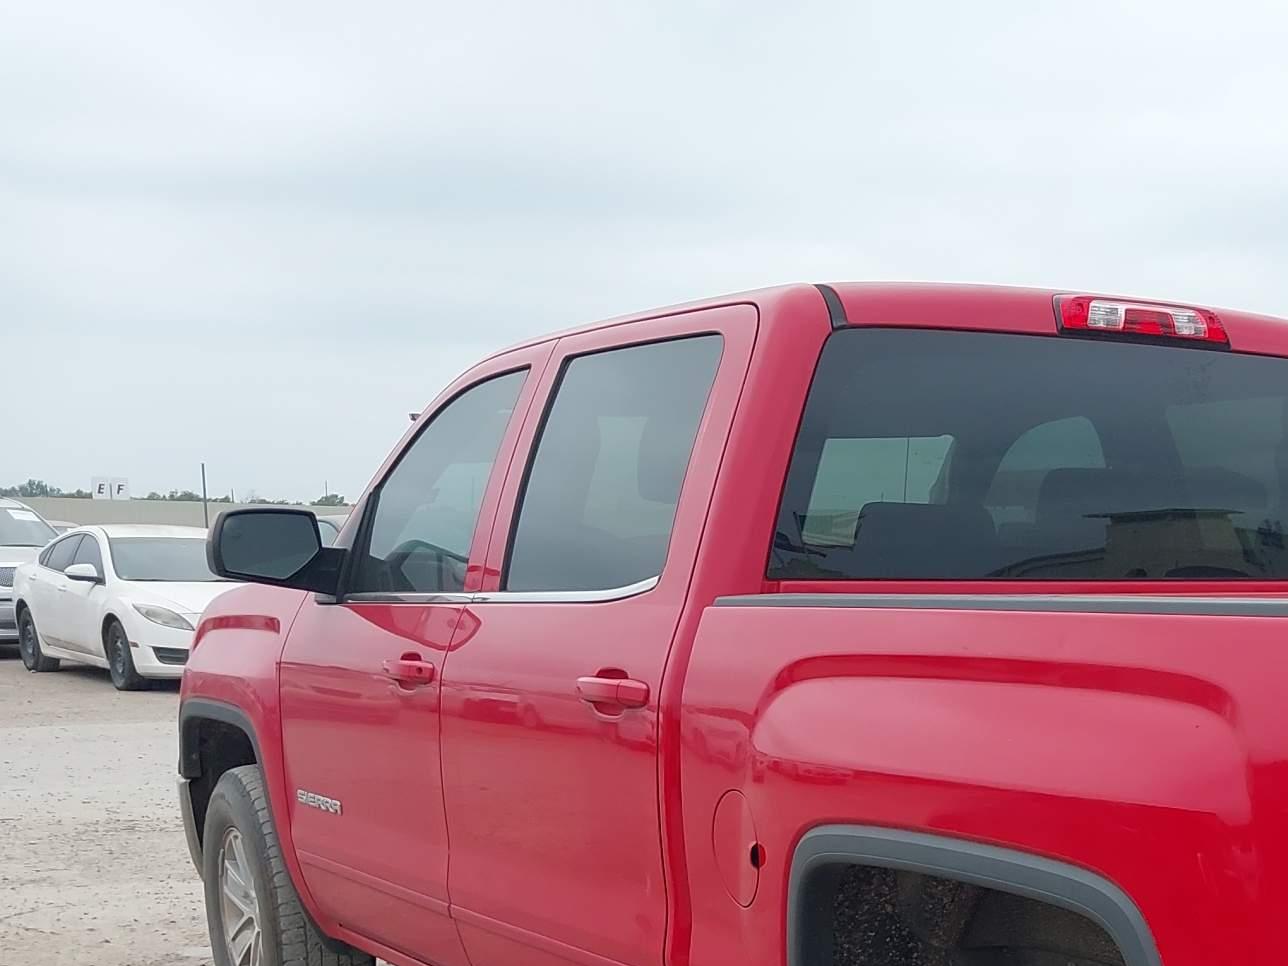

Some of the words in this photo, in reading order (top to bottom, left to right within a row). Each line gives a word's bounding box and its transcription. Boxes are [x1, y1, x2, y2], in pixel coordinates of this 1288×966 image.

[97, 483, 105, 495] E
[116, 484, 125, 496] F
[296, 788, 342, 817] SIERRA
